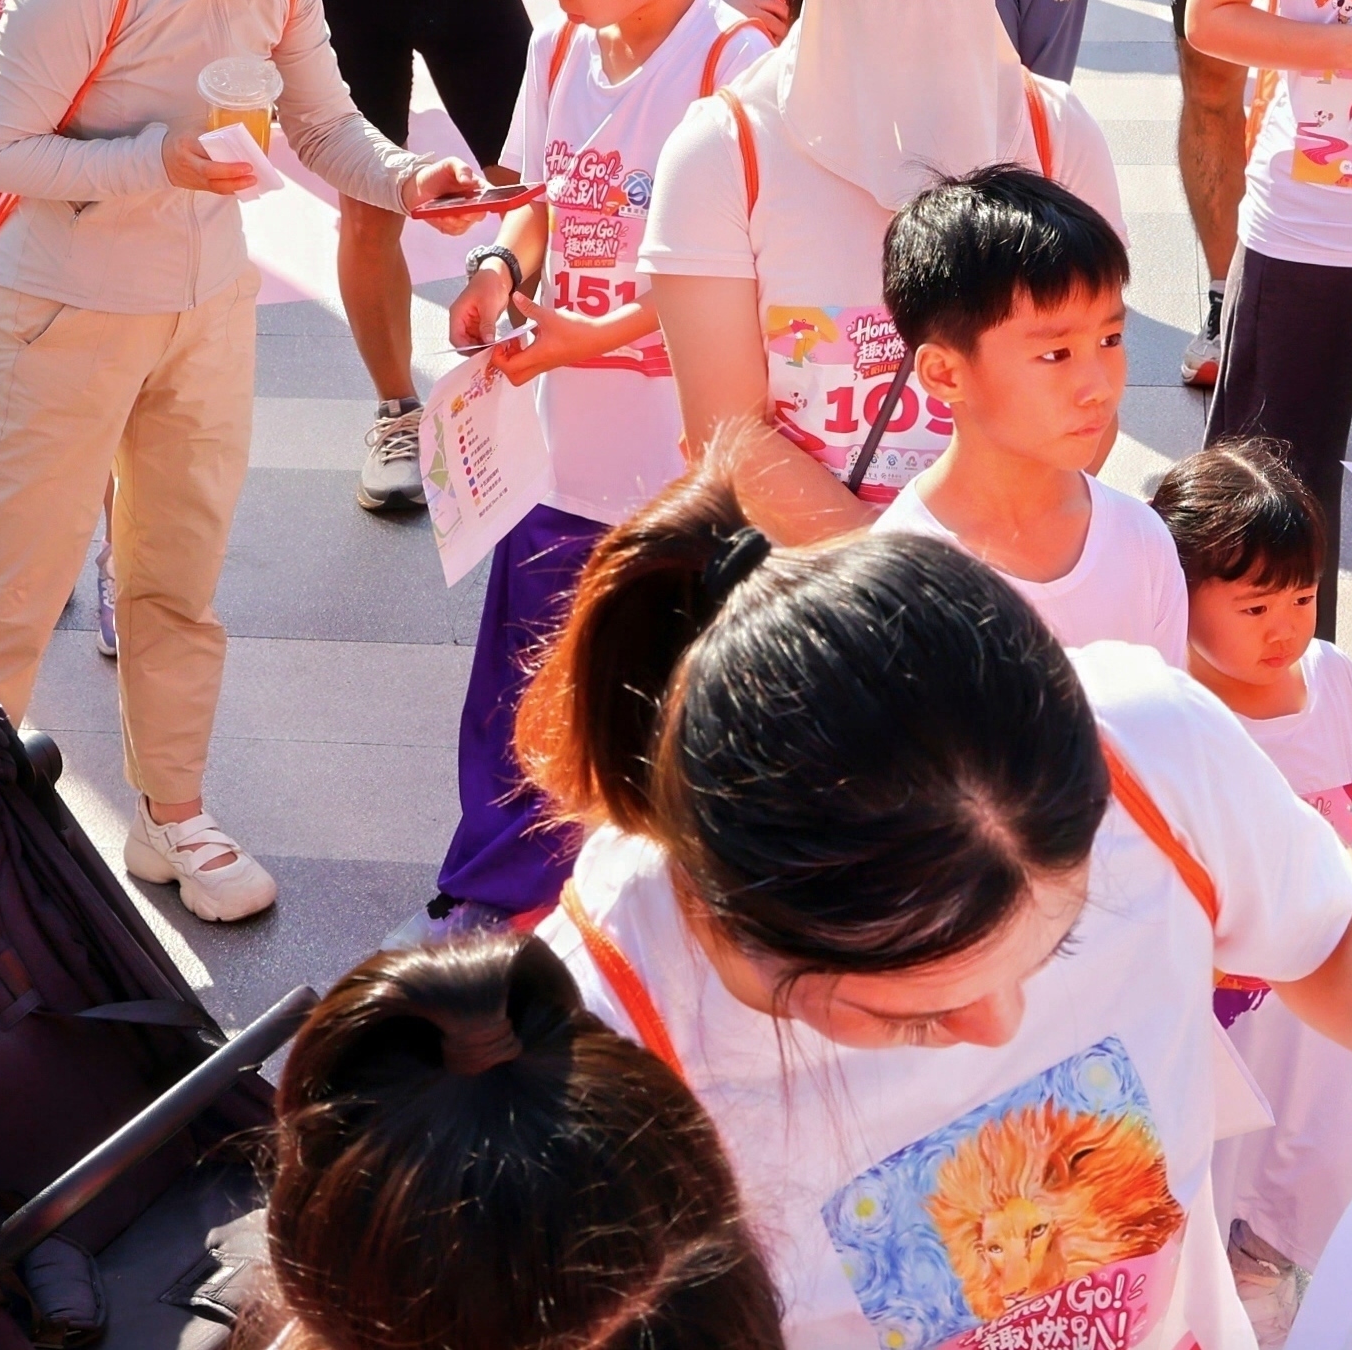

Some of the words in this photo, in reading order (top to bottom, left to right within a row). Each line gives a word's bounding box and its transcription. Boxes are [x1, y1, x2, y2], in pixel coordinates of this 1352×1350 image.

[578, 151, 616, 182] Go!
[561, 217, 596, 241] Honey
[596, 218, 621, 239] Go!
[554, 270, 637, 318] 151
[849, 316, 901, 344] Hone
[1066, 1273, 1126, 1315] Go!
